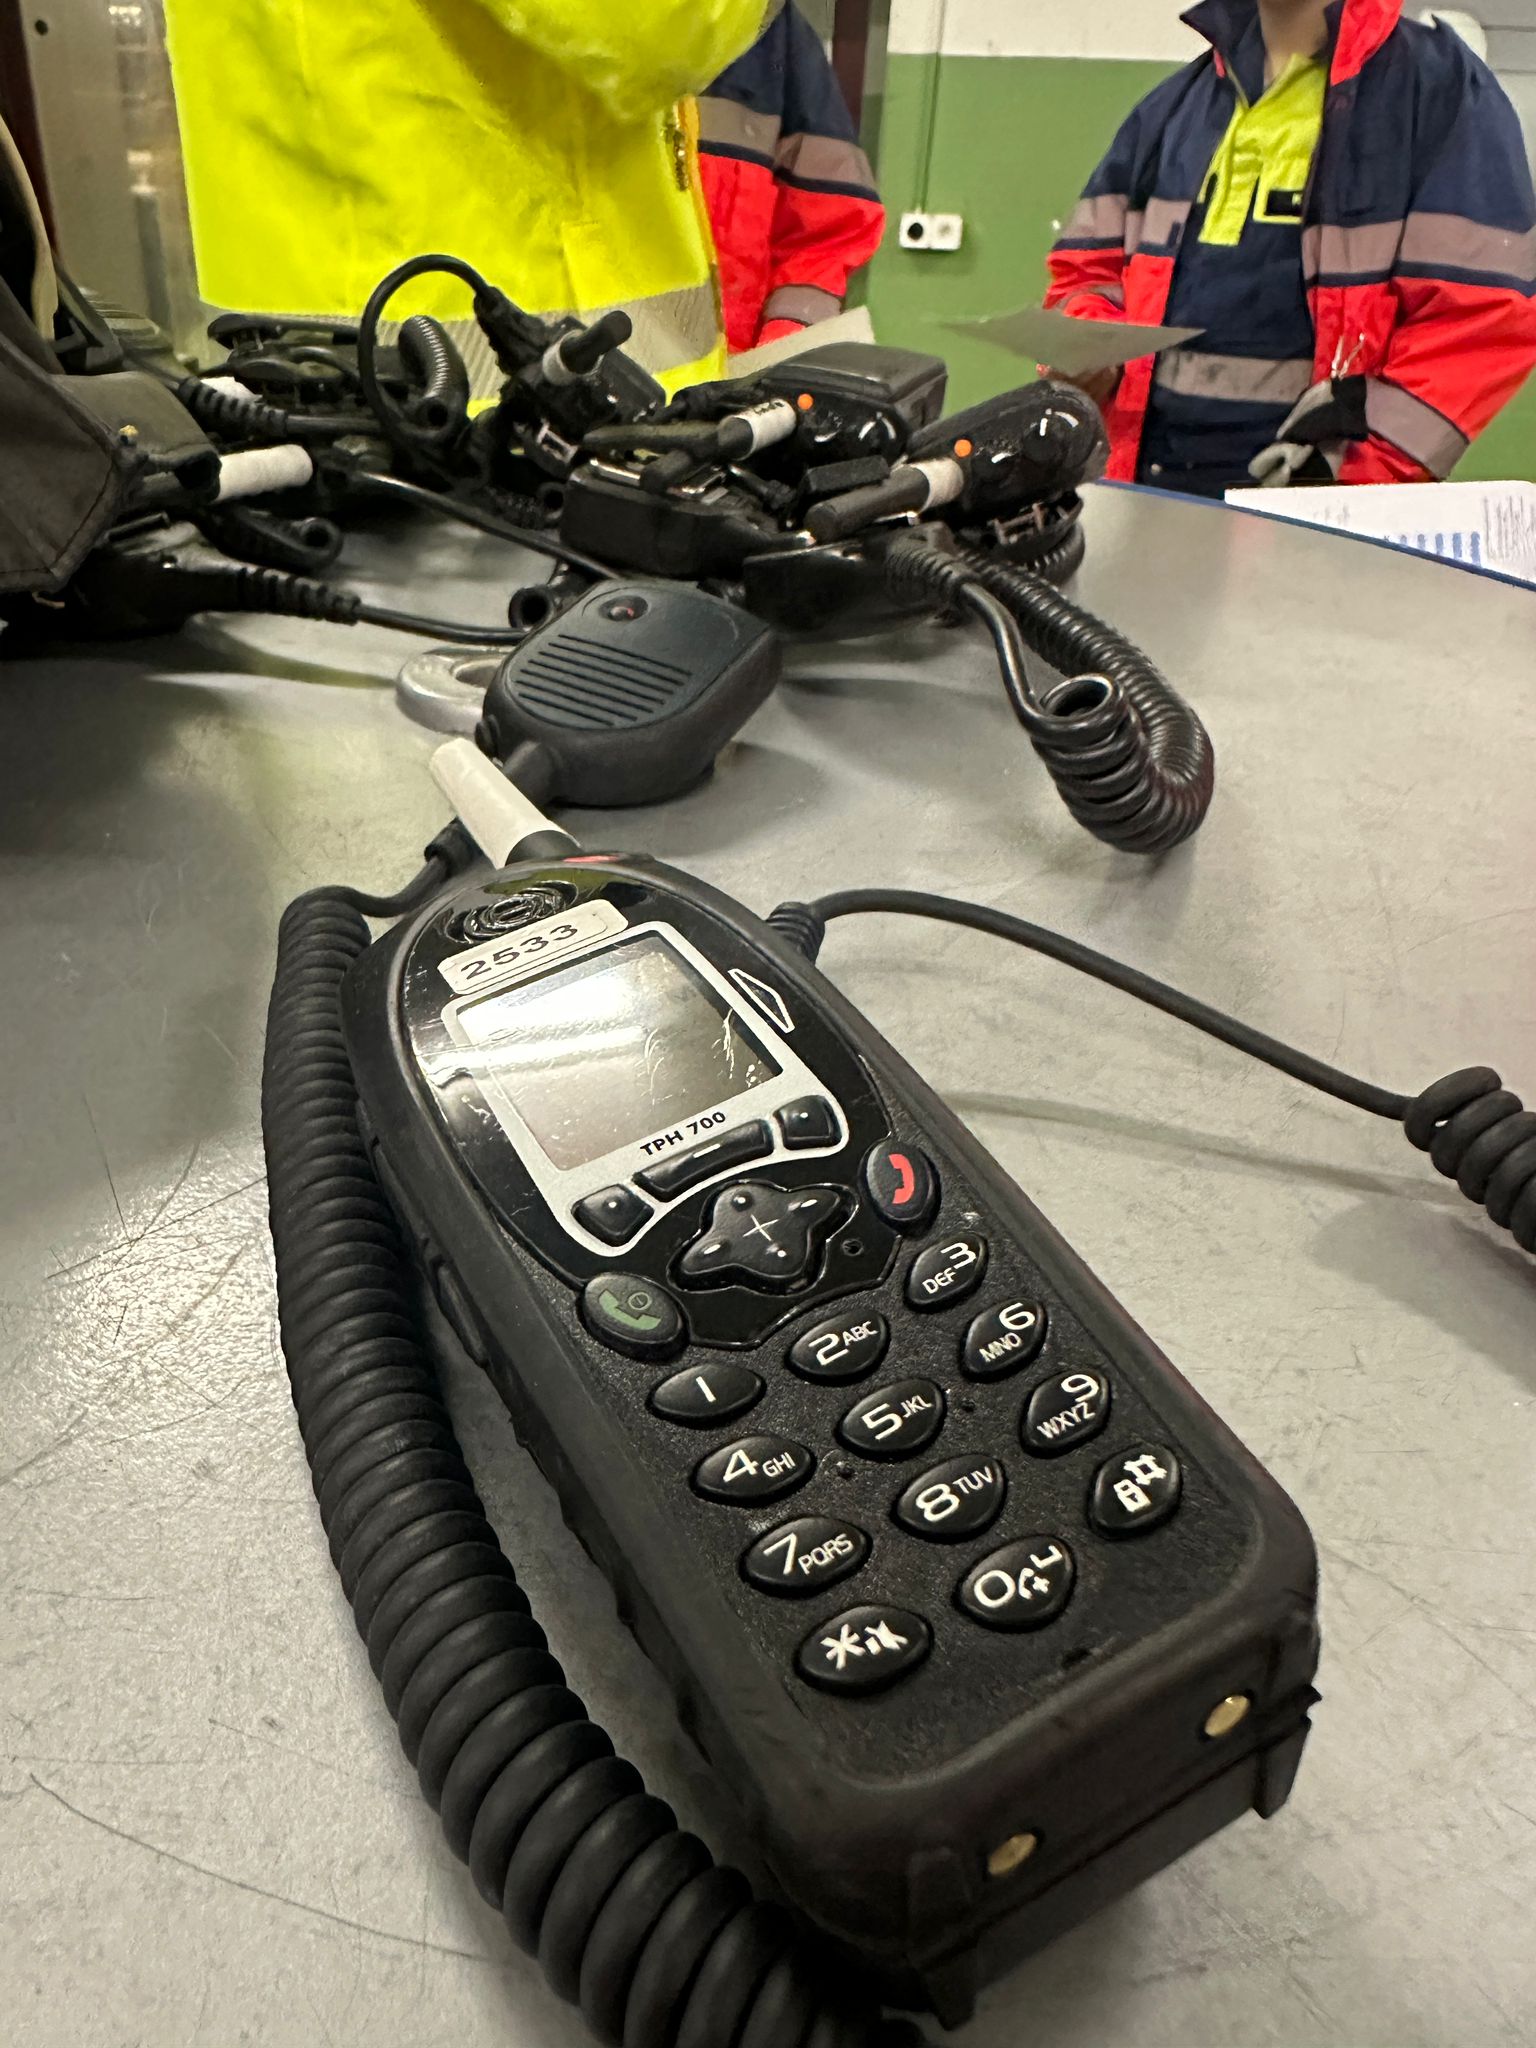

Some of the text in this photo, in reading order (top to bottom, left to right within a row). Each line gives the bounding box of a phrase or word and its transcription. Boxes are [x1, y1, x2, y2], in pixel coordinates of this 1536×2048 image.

[460, 924, 578, 980] 2533
[639, 1111, 727, 1157] TPH 700
[940, 1242, 977, 1270] 3
[922, 1267, 957, 1294] DEF
[998, 1302, 1036, 1331] 6
[842, 1320, 878, 1346] ABC
[979, 1332, 1021, 1362] MNO
[1060, 1374, 1099, 1403] 9
[900, 1395, 933, 1418] JKL
[1036, 1401, 1096, 1439] WXYZ
[762, 1452, 796, 1478] GHI
[952, 1466, 993, 1495] TUV
